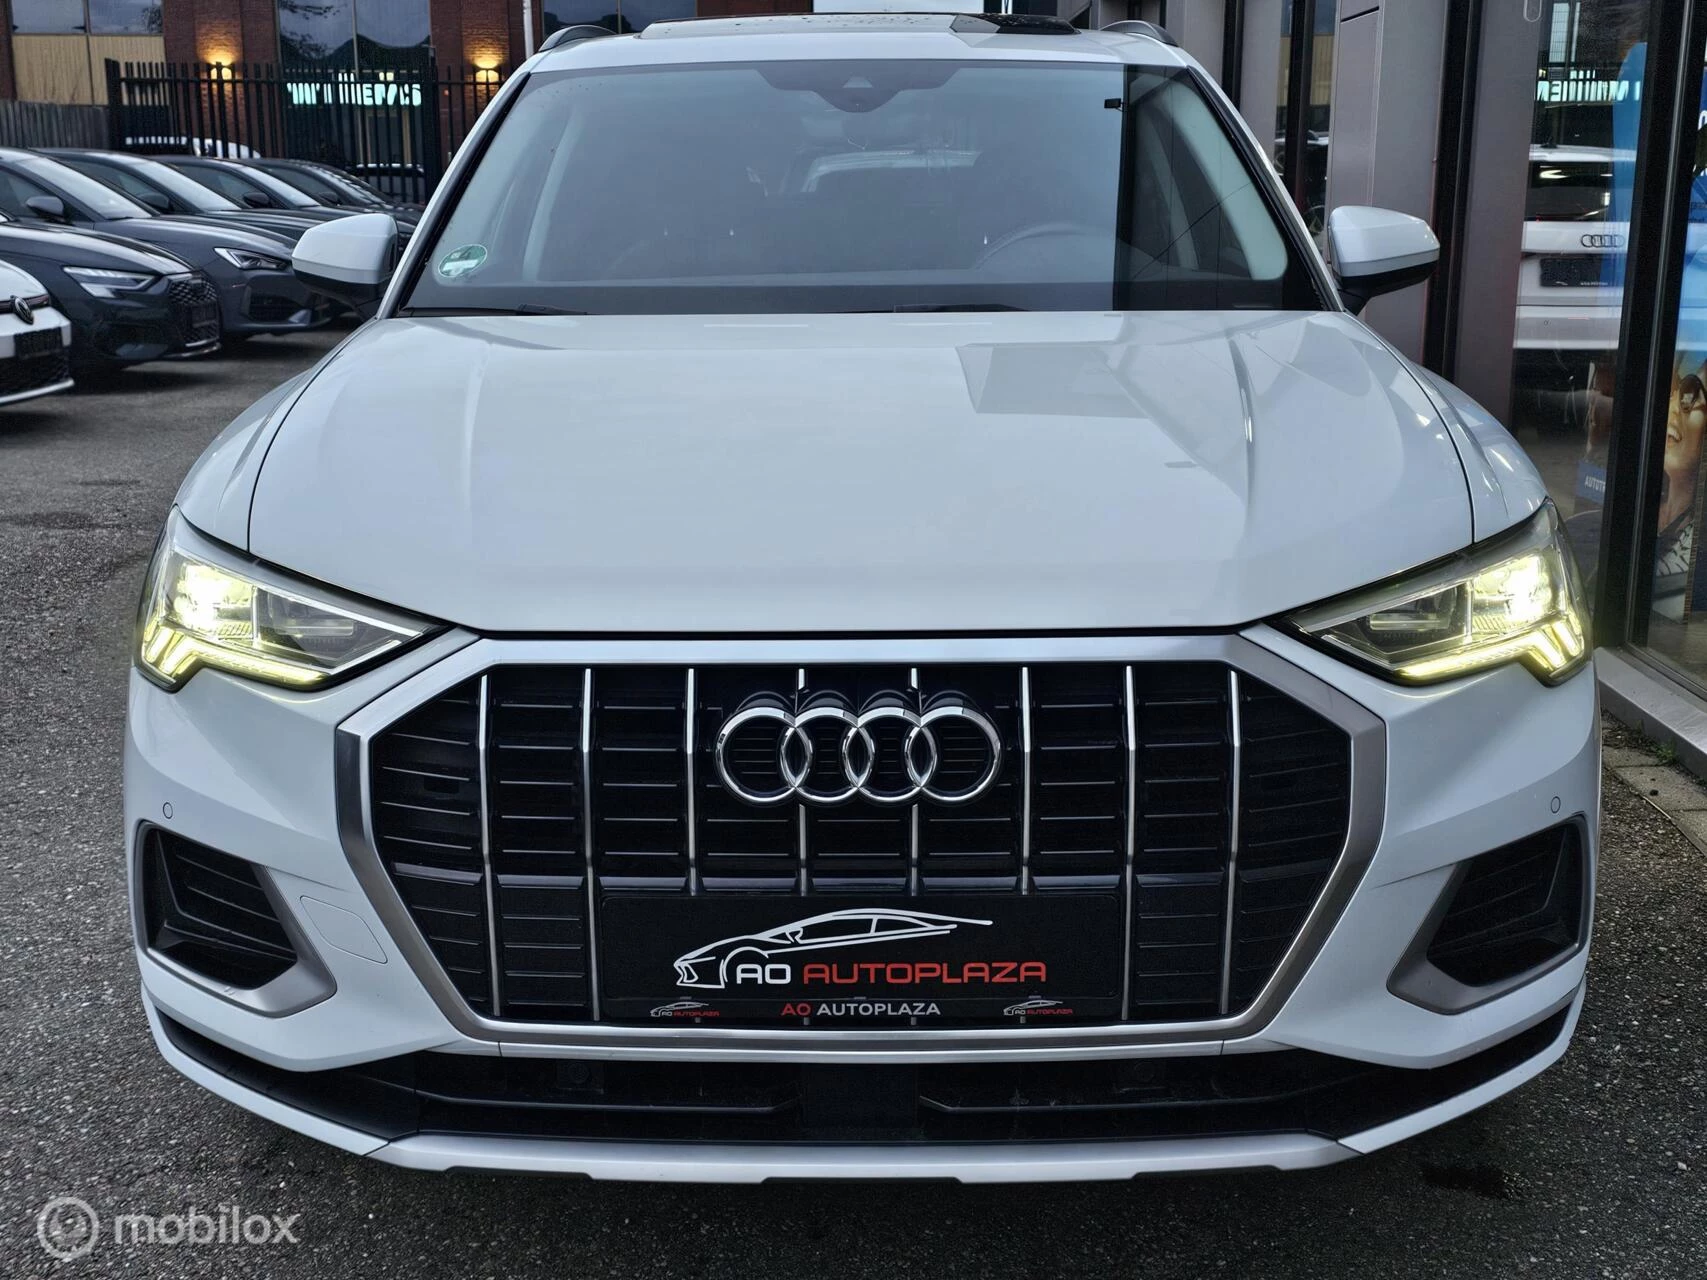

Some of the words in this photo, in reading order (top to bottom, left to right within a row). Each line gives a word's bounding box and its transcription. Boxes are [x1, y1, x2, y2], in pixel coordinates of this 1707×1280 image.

[736, 963, 792, 984] AO
[803, 961, 1047, 984] AUTOPLAZA
[781, 1003, 812, 1016] AO
[816, 1003, 941, 1016] AUTOPLAZA
